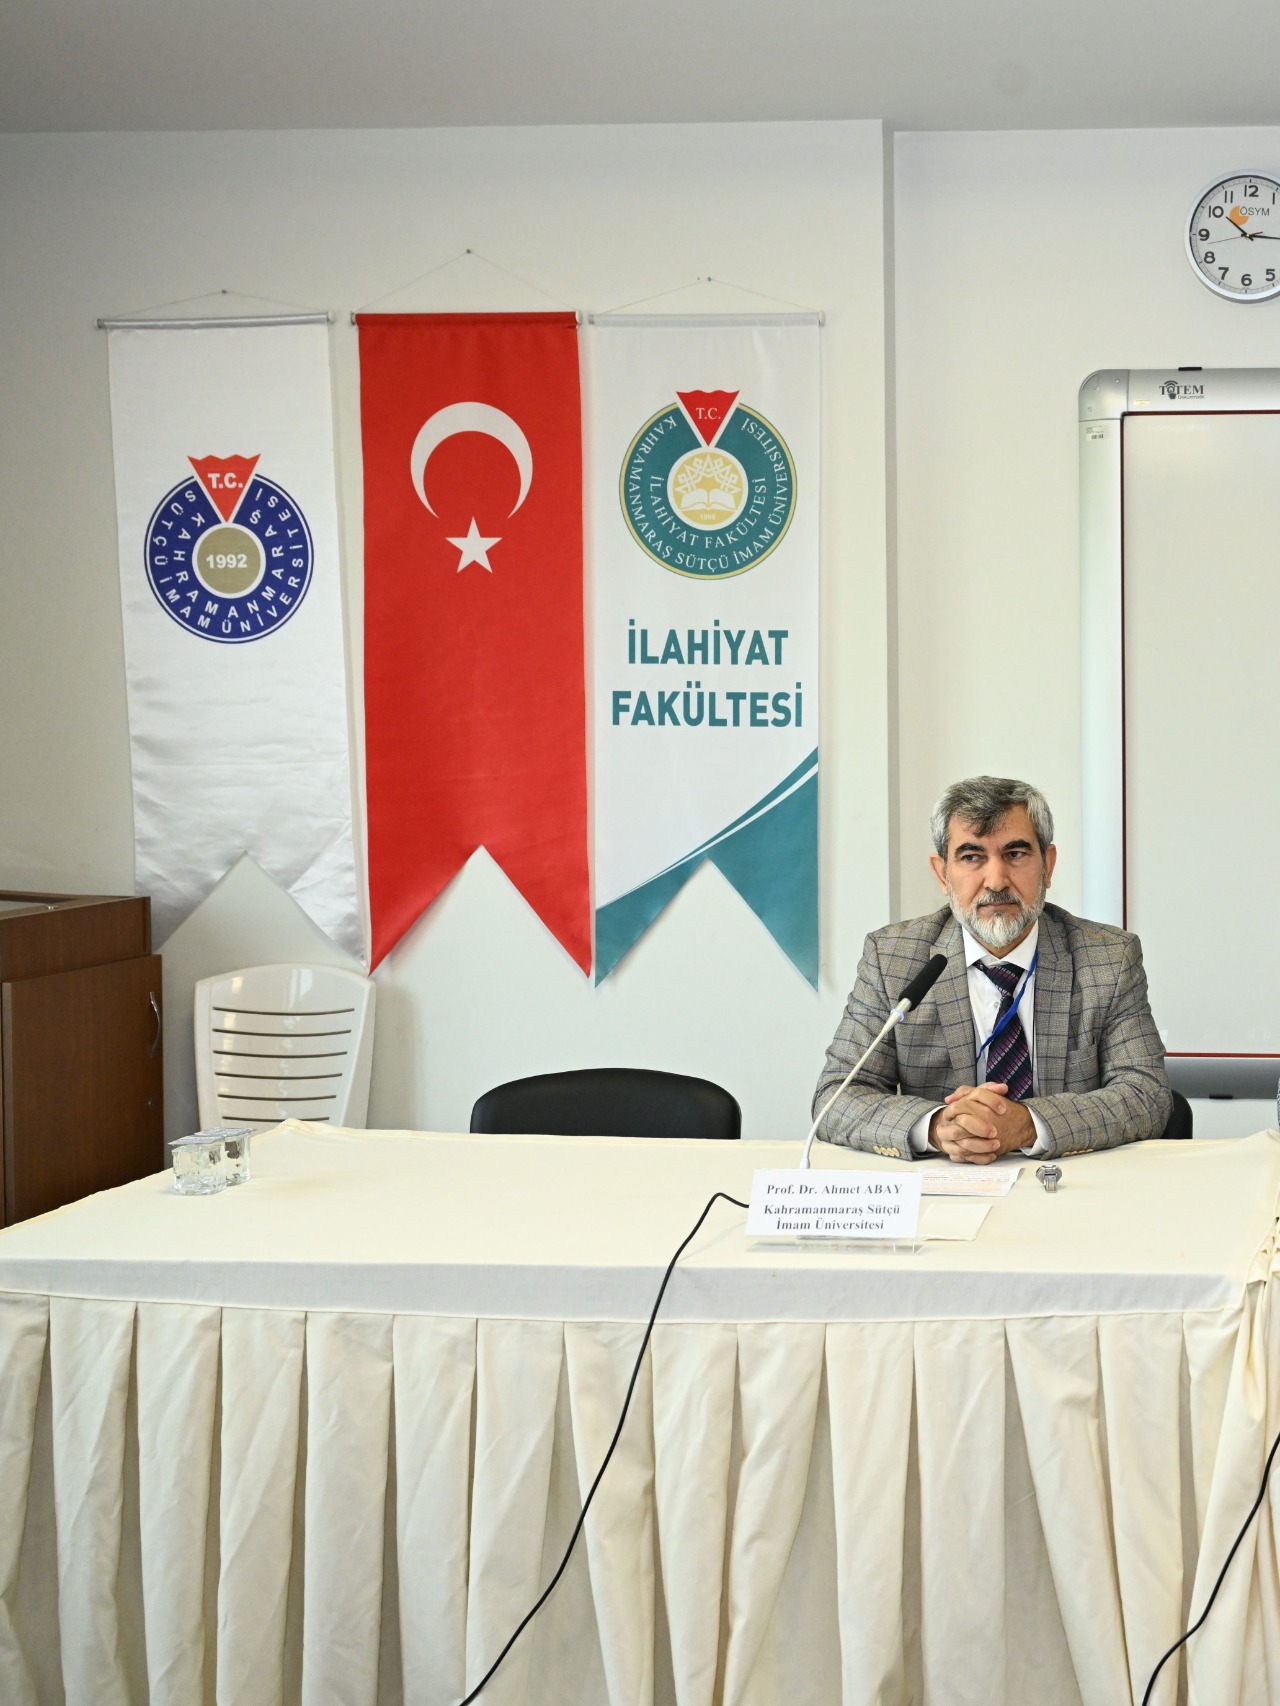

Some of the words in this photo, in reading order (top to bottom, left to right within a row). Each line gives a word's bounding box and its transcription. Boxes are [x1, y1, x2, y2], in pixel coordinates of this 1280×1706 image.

[1224, 190, 1233, 203] 11
[1244, 184, 1259, 197] 12
[1272, 192, 1276, 205] 1
[1208, 205, 1224, 218] 10
[1198, 228, 1210, 241] 9
[1203, 251, 1216, 264] 8
[1218, 266, 1229, 280] 7
[1241, 273, 1252, 286] 6
[1265, 268, 1276, 281] 5
[1159, 383, 1204, 396] TOTEM
[695, 407, 721, 420] T.C.
[741, 417, 788, 526] ÜNİVERSİTESİ
[207, 472, 244, 489] T.C.
[629, 415, 677, 559] KAHRAMANMARAŞ
[649, 475, 699, 548] İLAHİYAT
[705, 477, 767, 549] FAKÜLTESİ
[153, 490, 196, 565] SÜTÇÜ
[733, 526, 775, 565] İMAM
[173, 509, 284, 618] KAHRAMANMARAŞ
[206, 553, 248, 569] 1992
[222, 488, 303, 633] ÜNİVERSİTESİ
[674, 552, 730, 573] SÜTÇÜ
[159, 576, 211, 629] İMAM
[628, 618, 789, 665] İLAHİYAT
[612, 681, 803, 727] FAKÜLTESİ
[767, 1184, 795, 1195] Prof.
[799, 1184, 817, 1195] Dr.
[821, 1184, 860, 1195] Ahmet
[864, 1184, 903, 1195] ABAY
[764, 1204, 864, 1217] Kahramanmaraş
[866, 1204, 900, 1217] Sütçü
[776, 1217, 811, 1230] İmam
[815, 1217, 884, 1230] Üniversitesi
